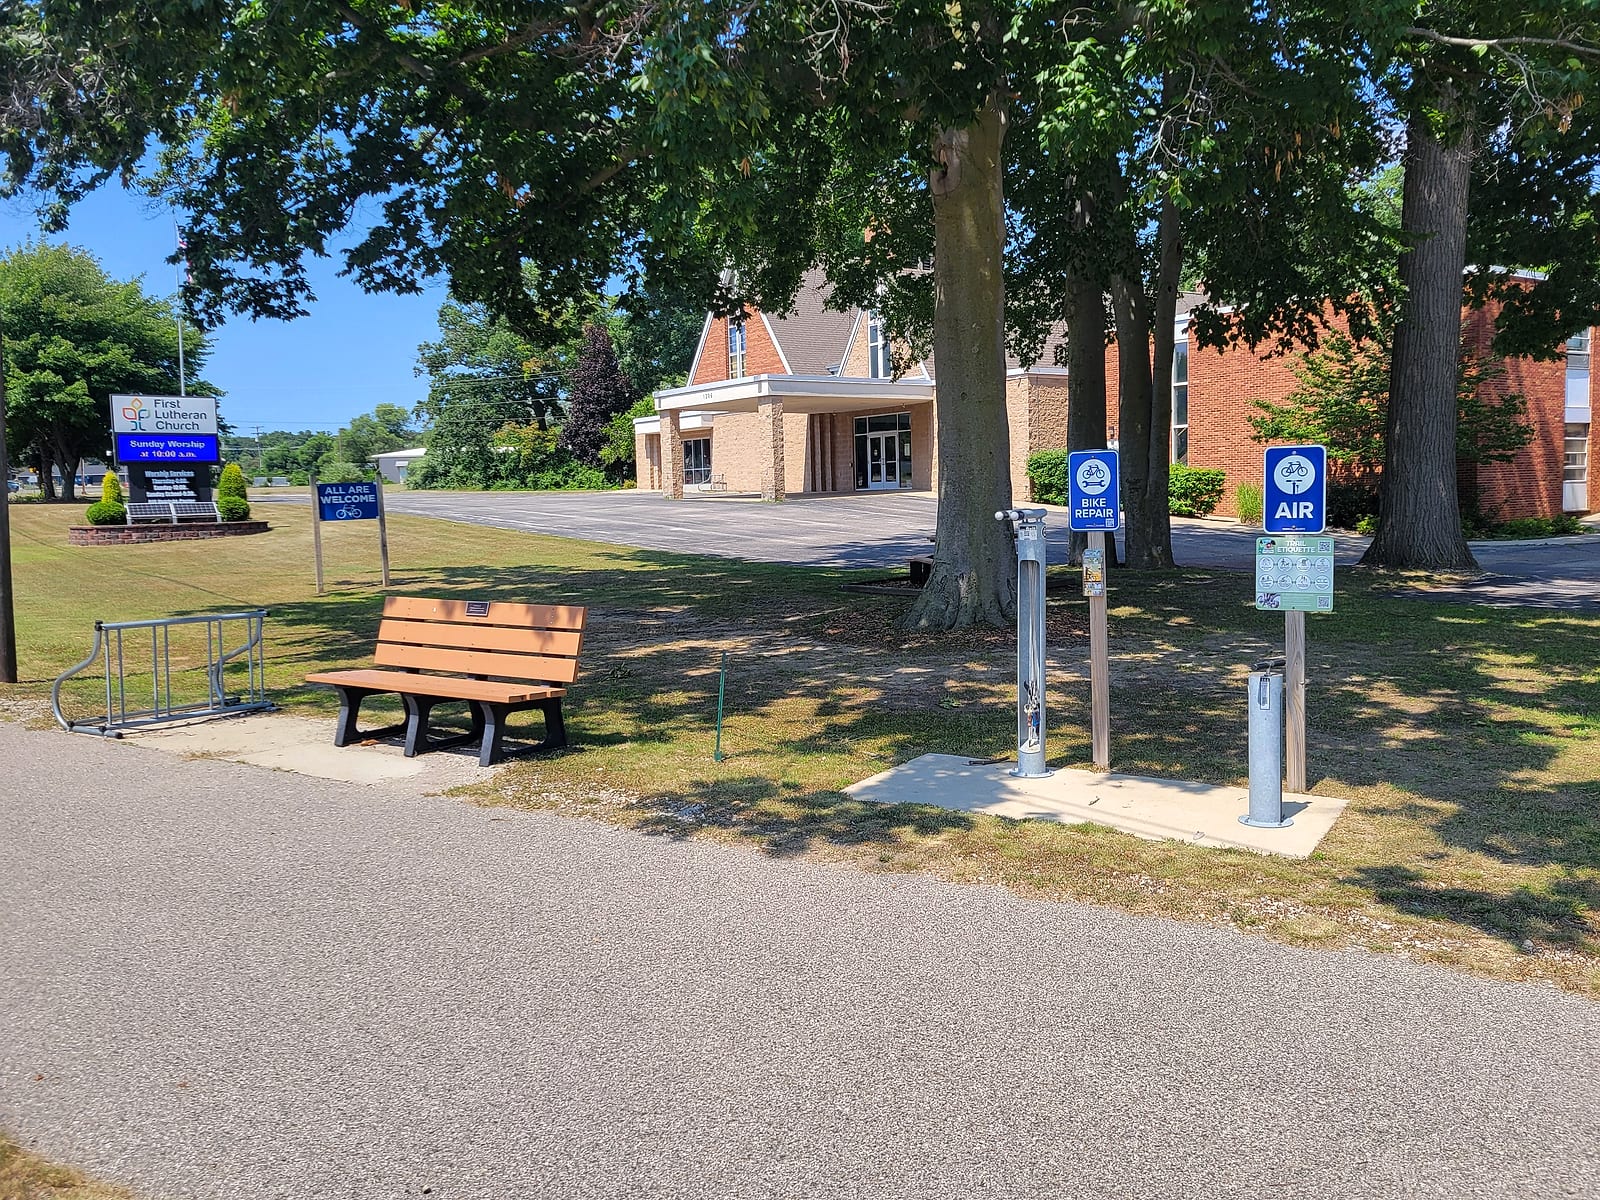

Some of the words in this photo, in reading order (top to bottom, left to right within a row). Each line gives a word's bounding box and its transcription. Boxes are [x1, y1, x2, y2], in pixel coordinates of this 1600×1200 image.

[154, 399, 181, 409] First
[154, 410, 207, 420] Lutheran
[155, 420, 199, 431] Church
[129, 440, 165, 449] Sunday
[167, 440, 205, 449] Worship
[152, 450, 176, 458] 10:00
[325, 486, 346, 494] ALL
[348, 485, 370, 494] ARE
[320, 494, 376, 504] WELCOME
[1081, 497, 1107, 507] BIKE
[1075, 508, 1114, 518] REPAIR
[1274, 501, 1314, 519] AIR
